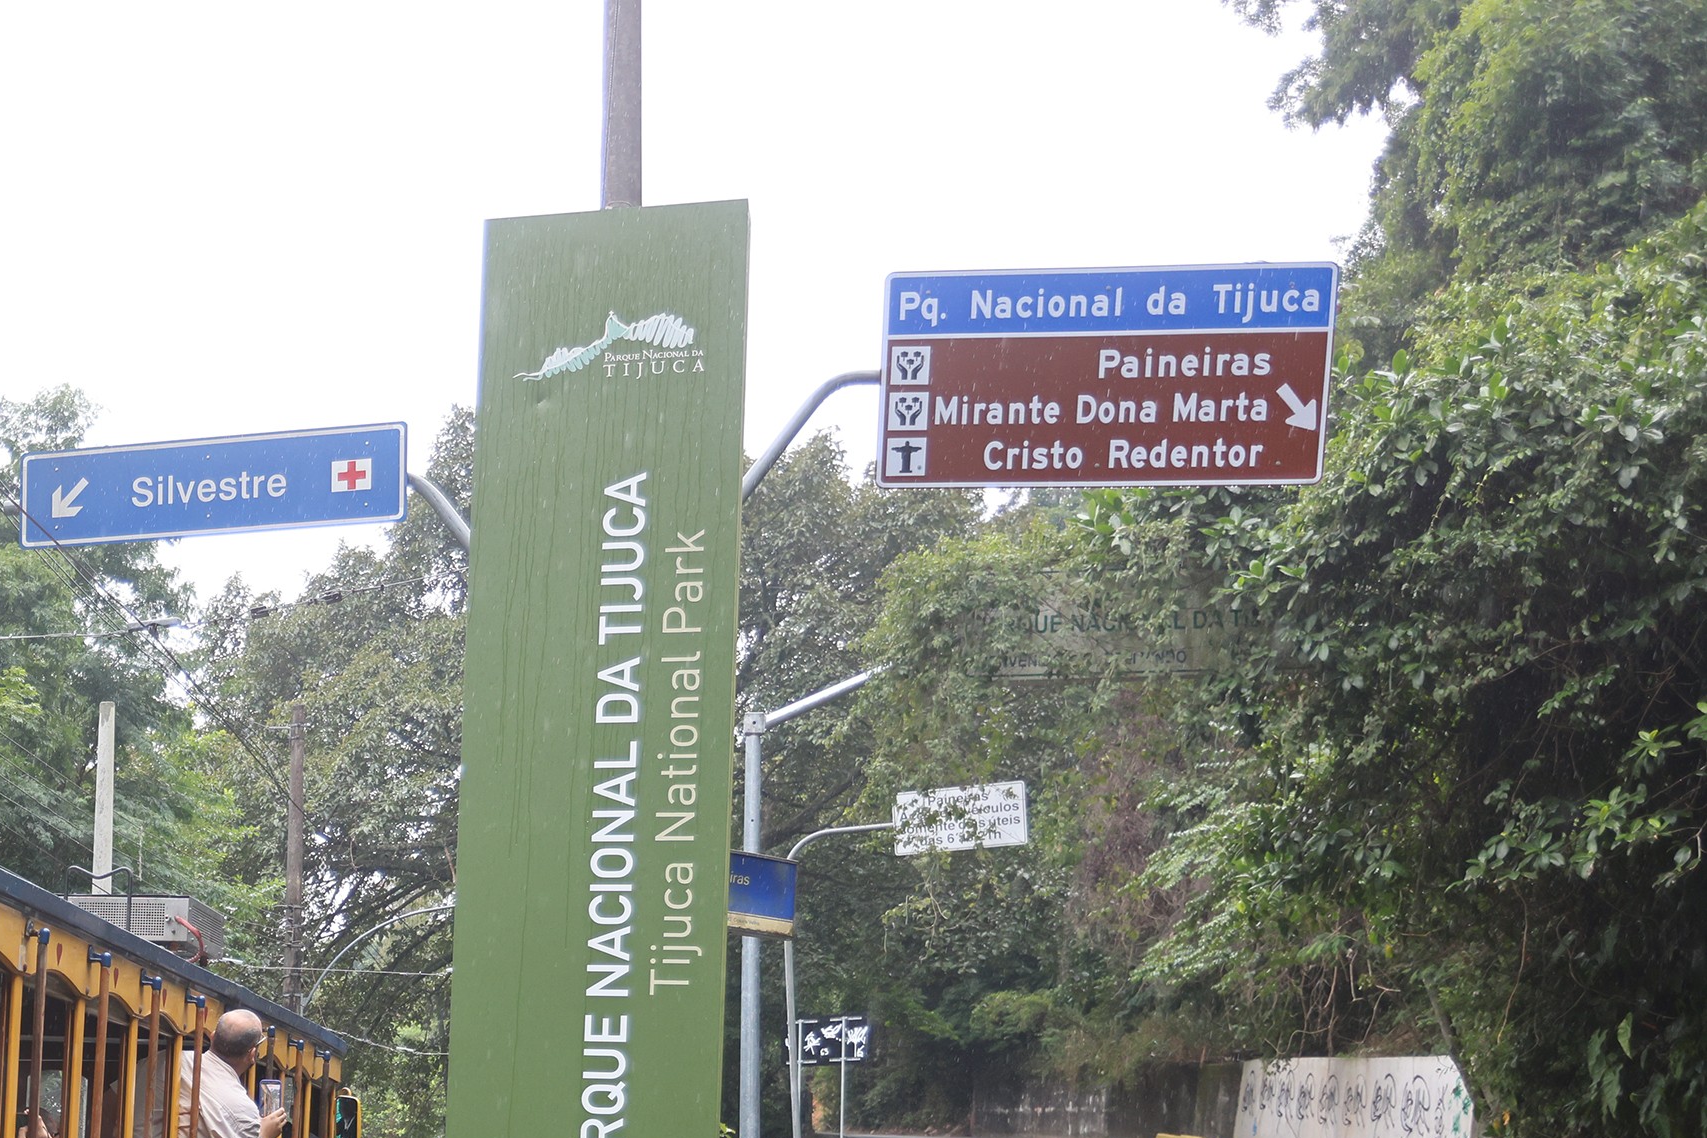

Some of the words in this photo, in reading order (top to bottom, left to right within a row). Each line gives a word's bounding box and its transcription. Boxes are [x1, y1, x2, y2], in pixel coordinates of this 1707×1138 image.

[899, 291, 946, 327] Pq.
[970, 287, 1123, 320] Nacional
[1146, 286, 1186, 316] da
[1213, 283, 1320, 323] Tijuca
[603, 359, 705, 379] TIJUCA
[1098, 346, 1271, 379] Paineiras
[934, 395, 1060, 426] Mirante
[1076, 394, 1157, 425] Dona
[1172, 391, 1267, 423] Marta
[983, 440, 1083, 471] Cristo
[1108, 438, 1264, 469] Redentor
[132, 471, 287, 507] Silvestre
[598, 472, 648, 645] TIJUCA
[662, 529, 705, 633] Park
[596, 656, 641, 723] DA
[655, 651, 701, 841] National
[902, 821, 955, 838] omente
[586, 741, 638, 997] NACIONAL
[649, 862, 702, 996] Tijuca
